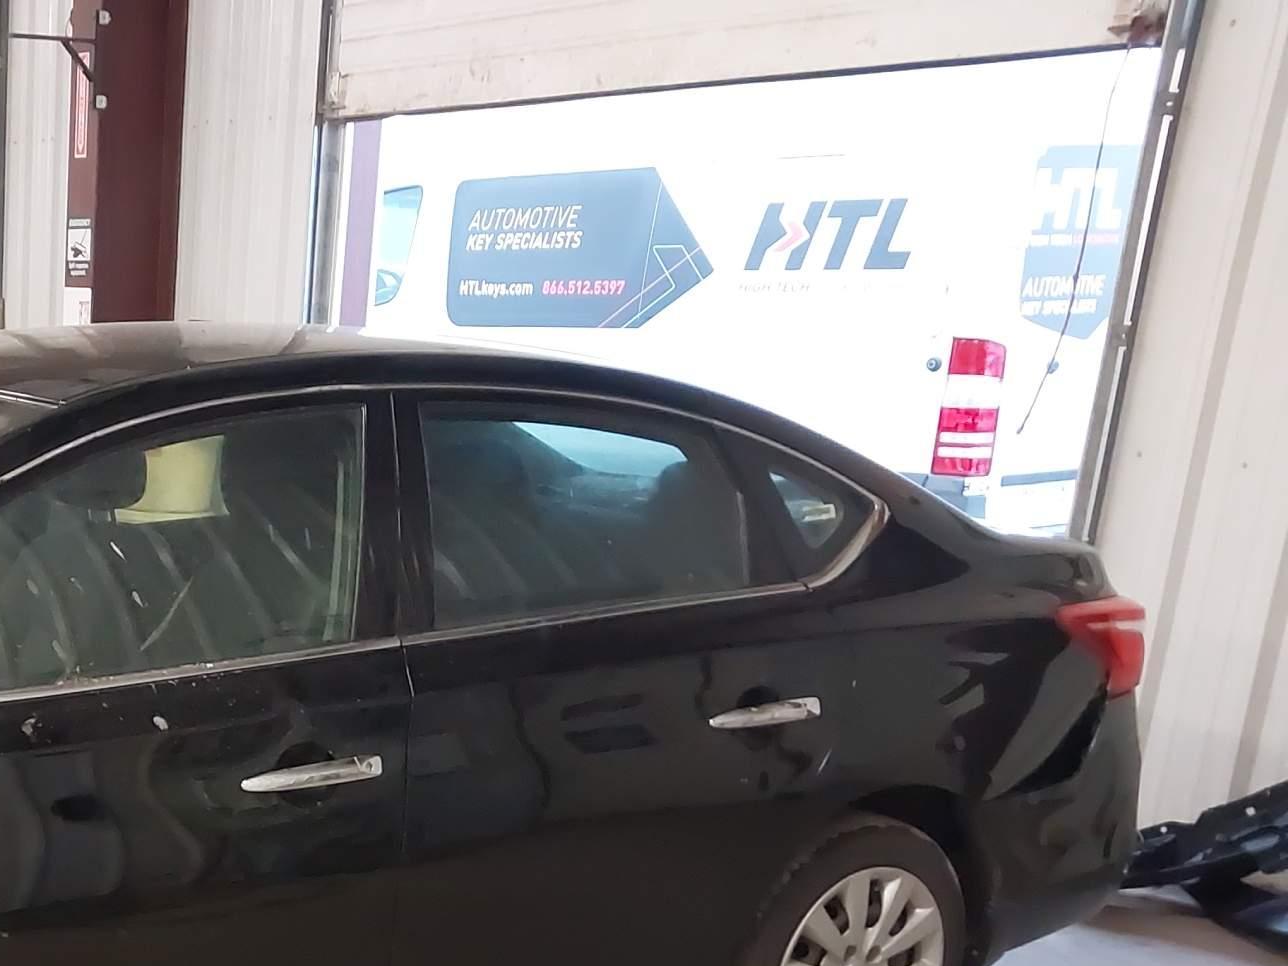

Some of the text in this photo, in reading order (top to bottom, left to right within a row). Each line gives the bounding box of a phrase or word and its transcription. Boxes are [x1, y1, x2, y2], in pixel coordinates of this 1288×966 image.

[468, 205, 582, 231] AUTOMOTIVE
[465, 231, 583, 251] KEY SPECIALISTS
[743, 198, 912, 271] HTL
[459, 279, 626, 299] HTLkeys.com 866.512.5397
